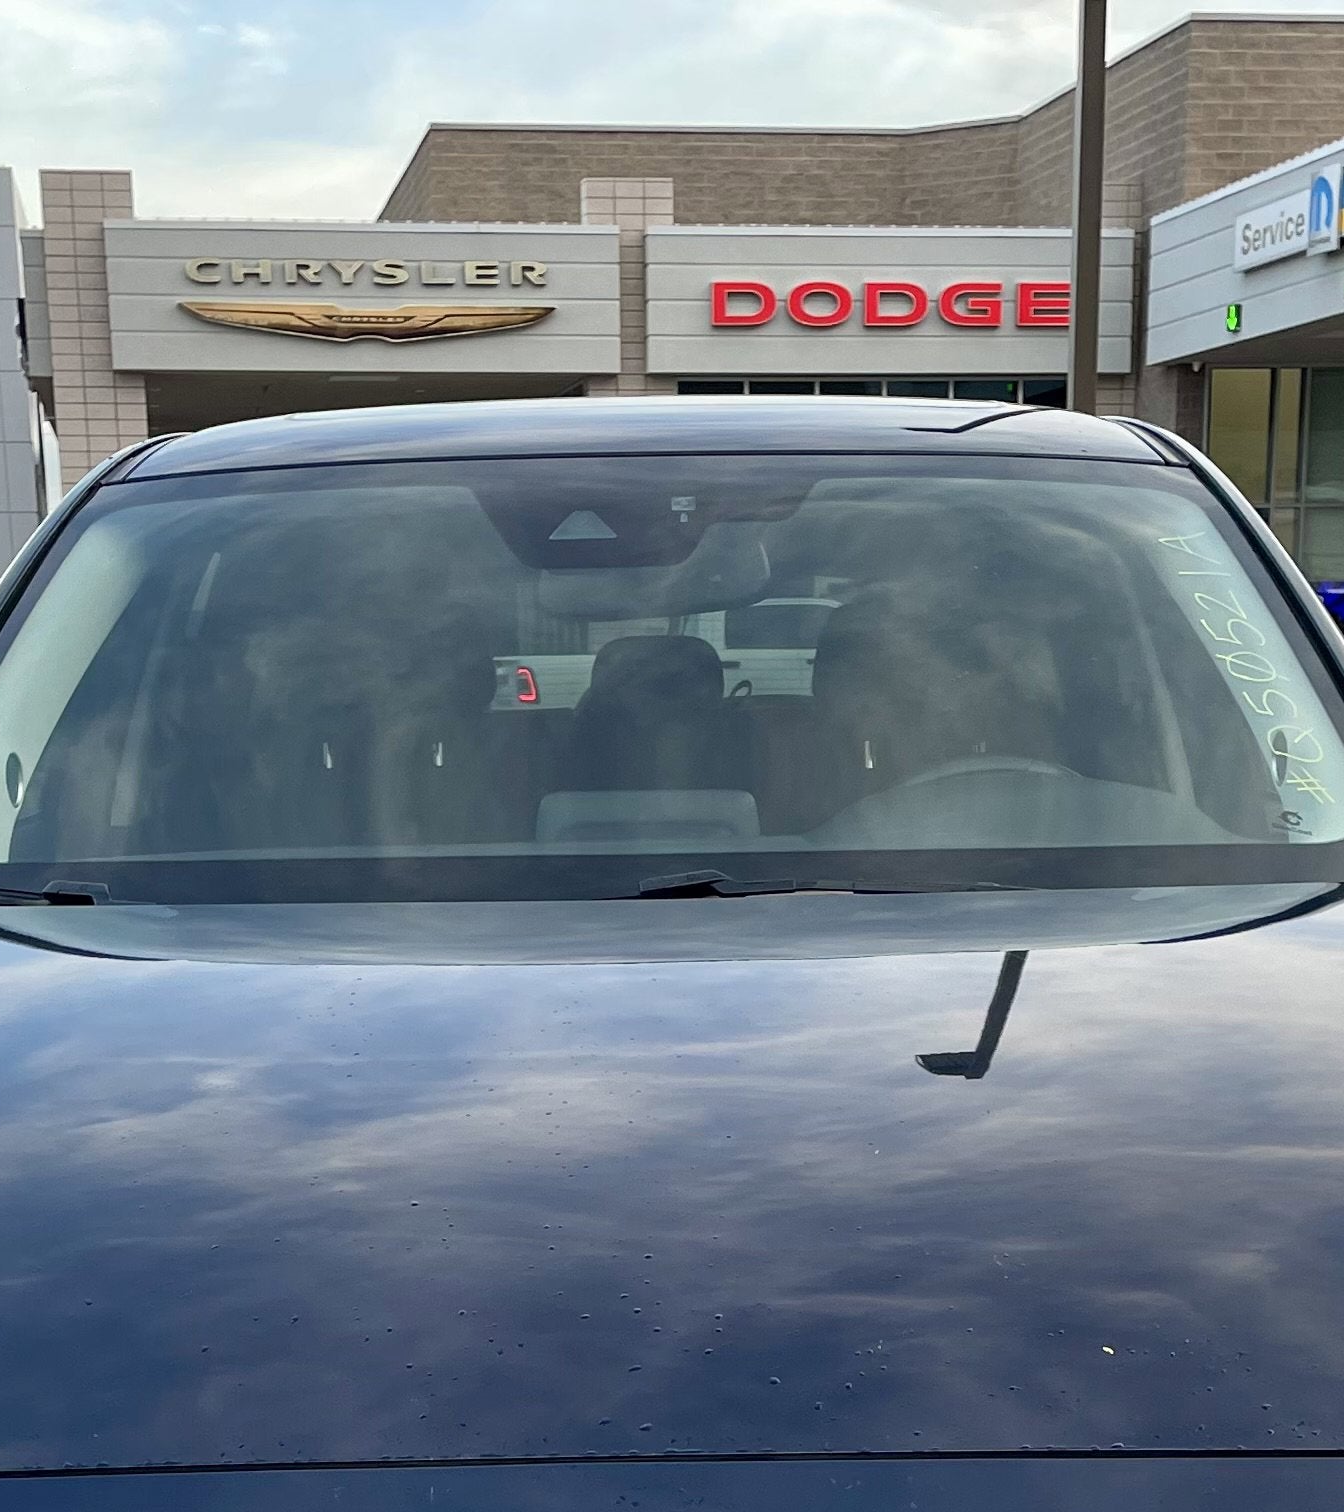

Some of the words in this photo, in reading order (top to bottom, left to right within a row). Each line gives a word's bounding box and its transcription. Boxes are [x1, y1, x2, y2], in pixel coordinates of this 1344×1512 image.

[1241, 211, 1305, 255] Service
[184, 257, 548, 286] CHRYSLER
[710, 281, 1071, 328] DODGE
